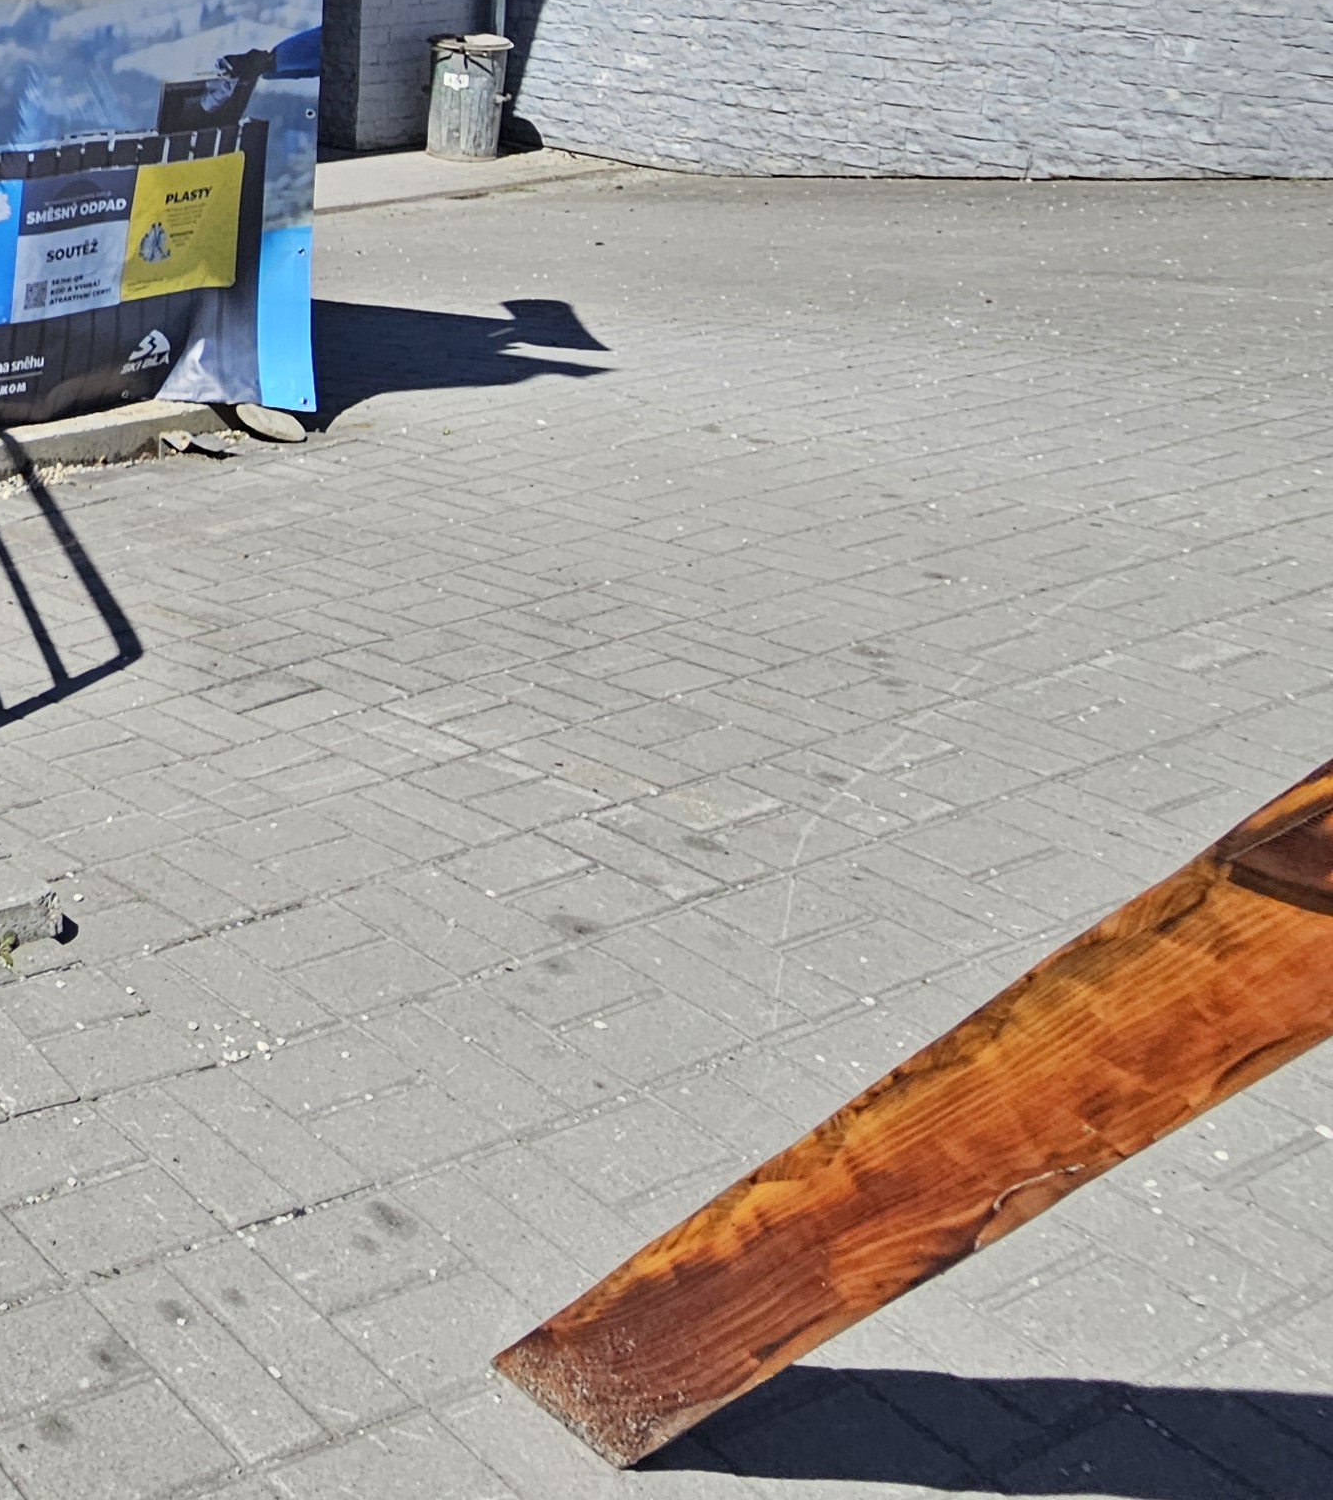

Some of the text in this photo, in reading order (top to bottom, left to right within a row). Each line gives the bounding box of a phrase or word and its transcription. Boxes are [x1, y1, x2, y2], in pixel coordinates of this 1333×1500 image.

[165, 185, 213, 205] PLASTY
[26, 201, 78, 226] SMĚSNÝ
[79, 197, 128, 217] ODPAD
[46, 238, 99, 264] SOUTĚŽ
[11, 354, 45, 373] sněhu
